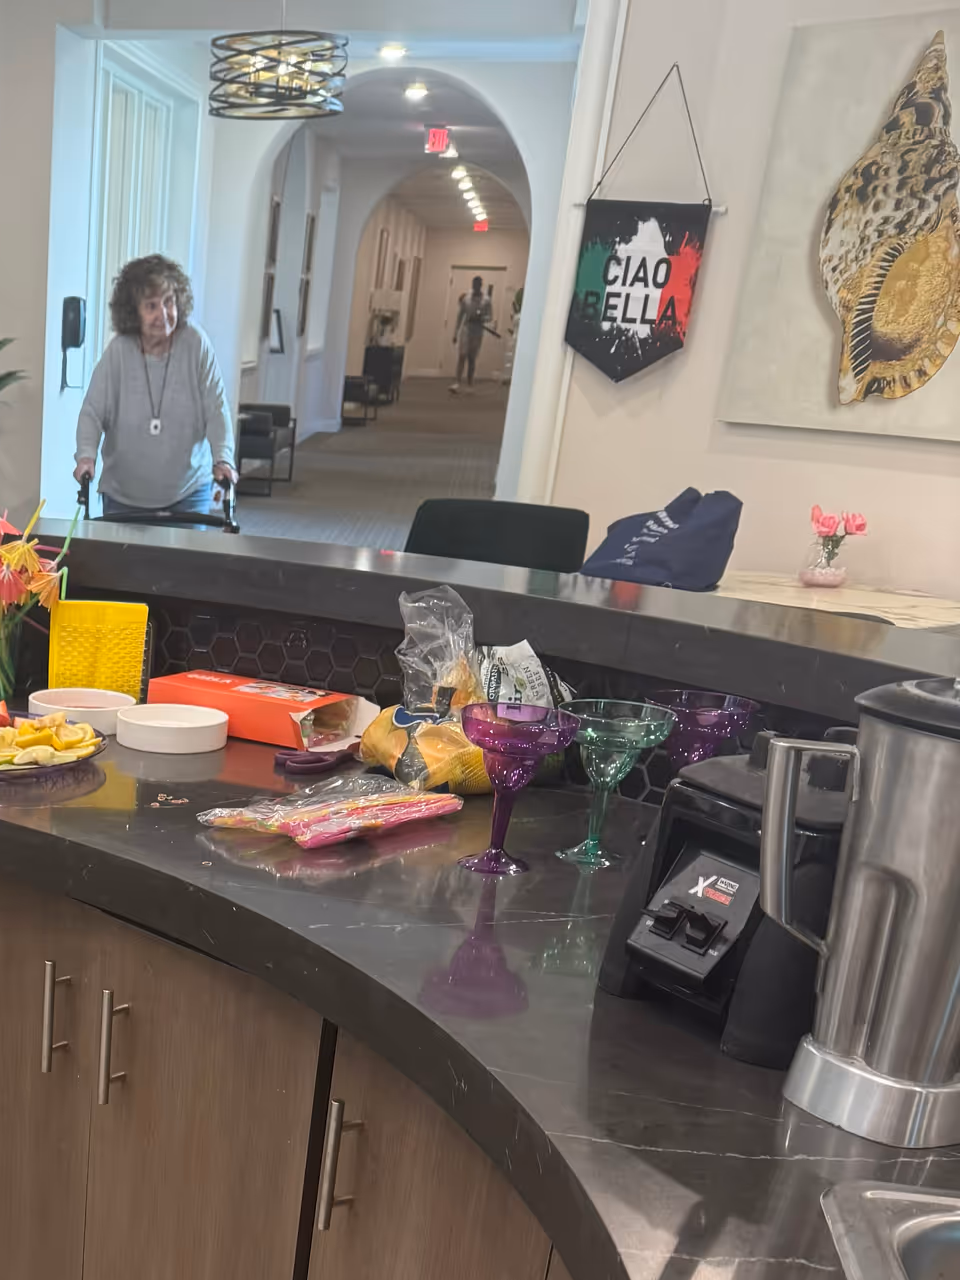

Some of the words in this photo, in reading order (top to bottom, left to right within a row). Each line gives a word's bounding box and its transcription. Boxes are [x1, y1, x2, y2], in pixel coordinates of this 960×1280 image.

[602, 254, 672, 289] CIAO
[581, 289, 678, 327] BELLA
[523, 666, 540, 697] GREEN
